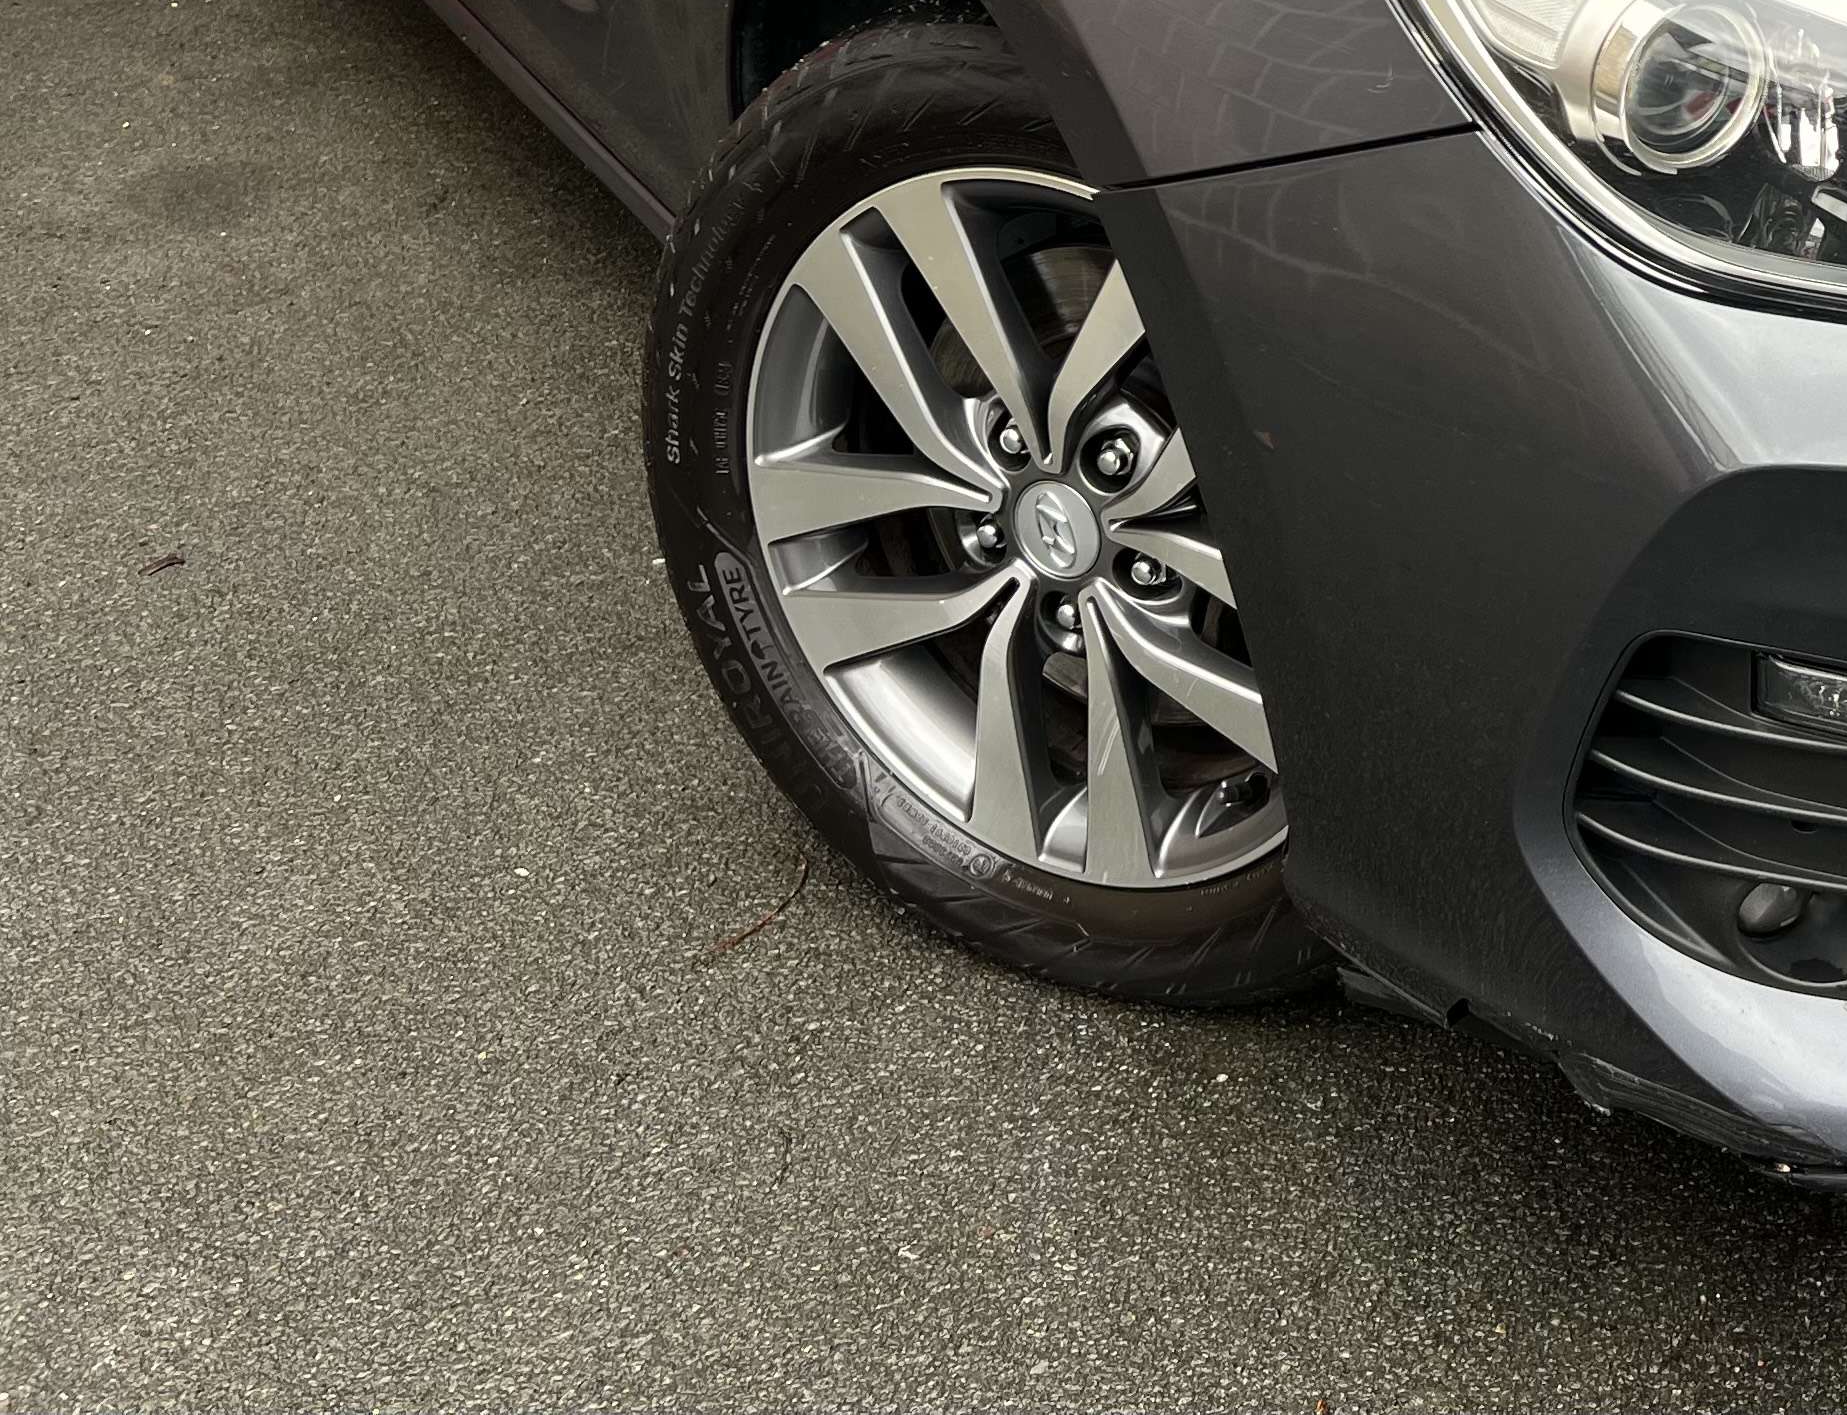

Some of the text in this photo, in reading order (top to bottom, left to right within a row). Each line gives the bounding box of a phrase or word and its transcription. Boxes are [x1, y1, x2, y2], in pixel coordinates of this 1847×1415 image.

[667, 322, 689, 382] Skin
[666, 387, 681, 465] Shark
[724, 567, 761, 636] TYRE
